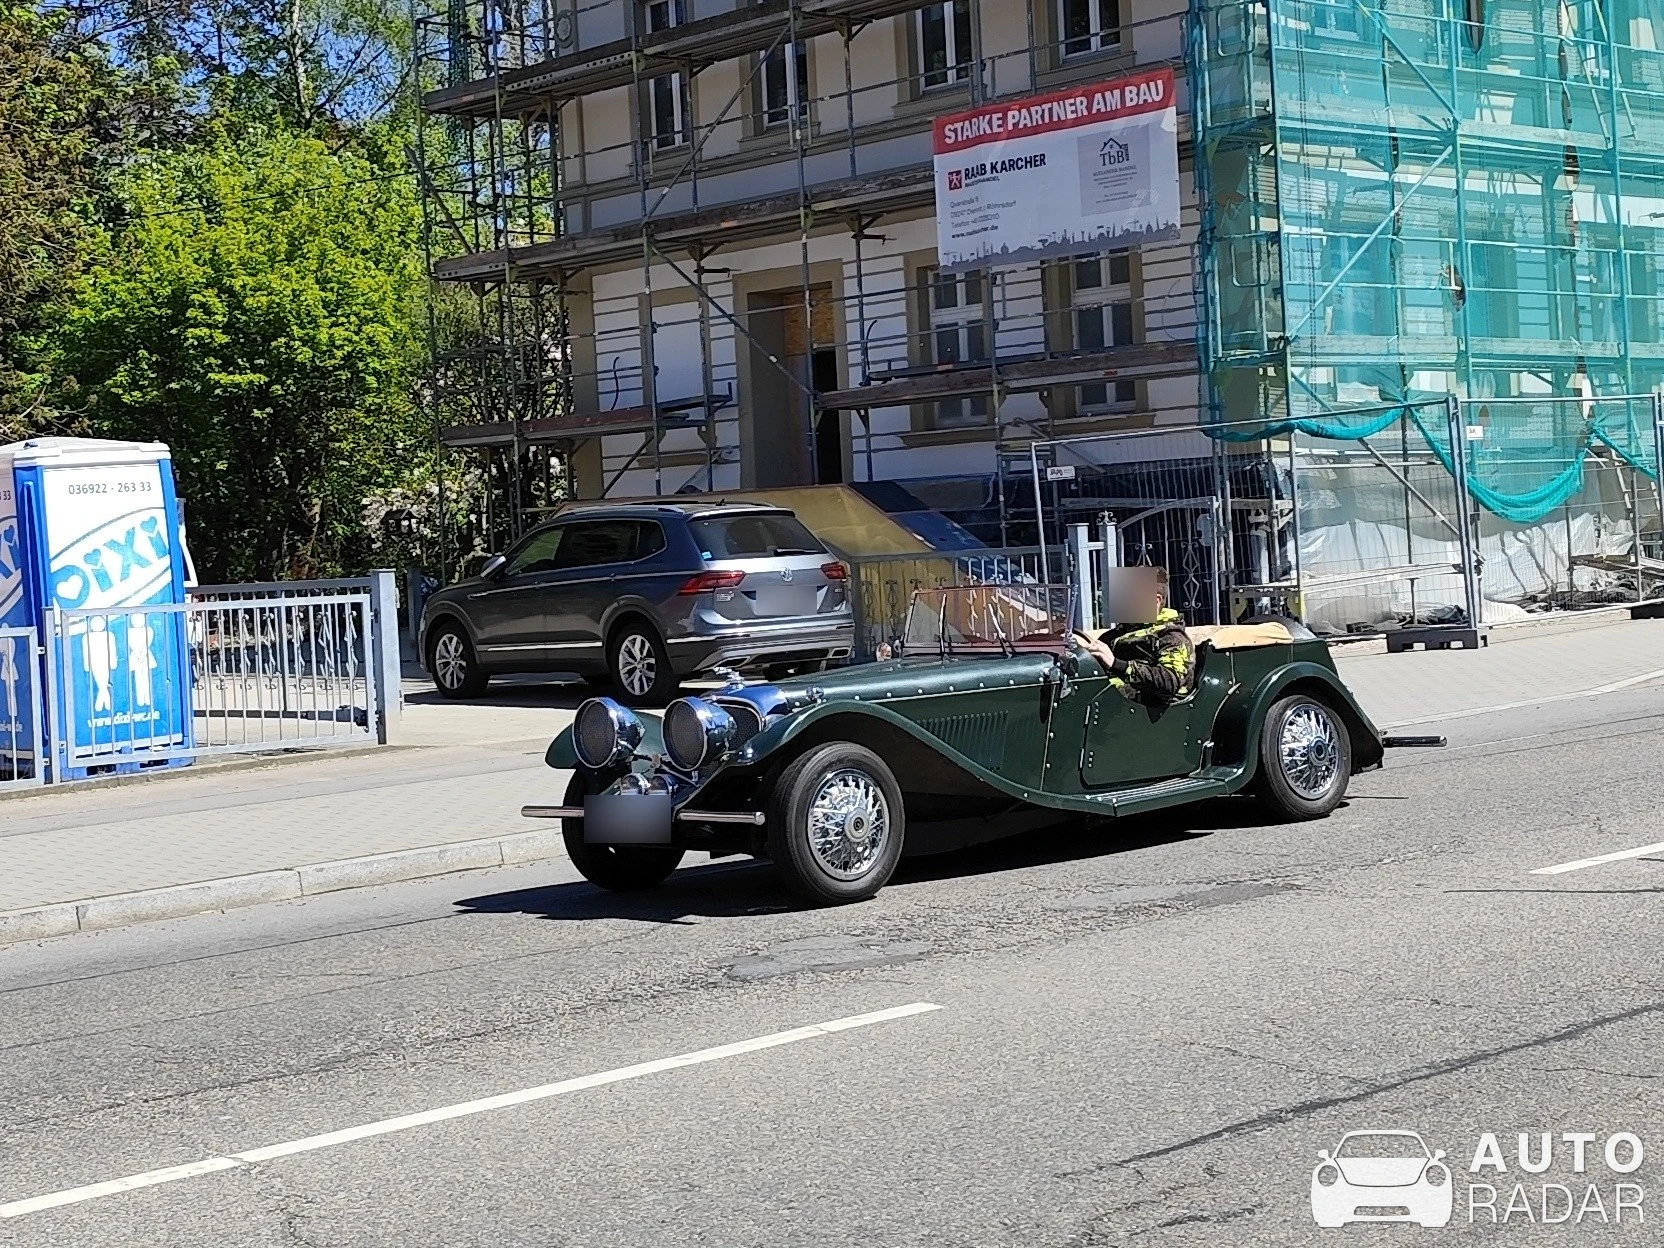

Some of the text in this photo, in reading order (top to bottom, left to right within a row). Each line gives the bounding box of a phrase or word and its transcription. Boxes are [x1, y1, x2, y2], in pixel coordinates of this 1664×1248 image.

[944, 79, 1164, 144] STARKE PARTNER AM BAU
[964, 153, 1046, 180] RAAB KARCHER
[68, 483, 107, 494] 036922
[117, 482, 136, 492] 263
[140, 481, 152, 492] 33
